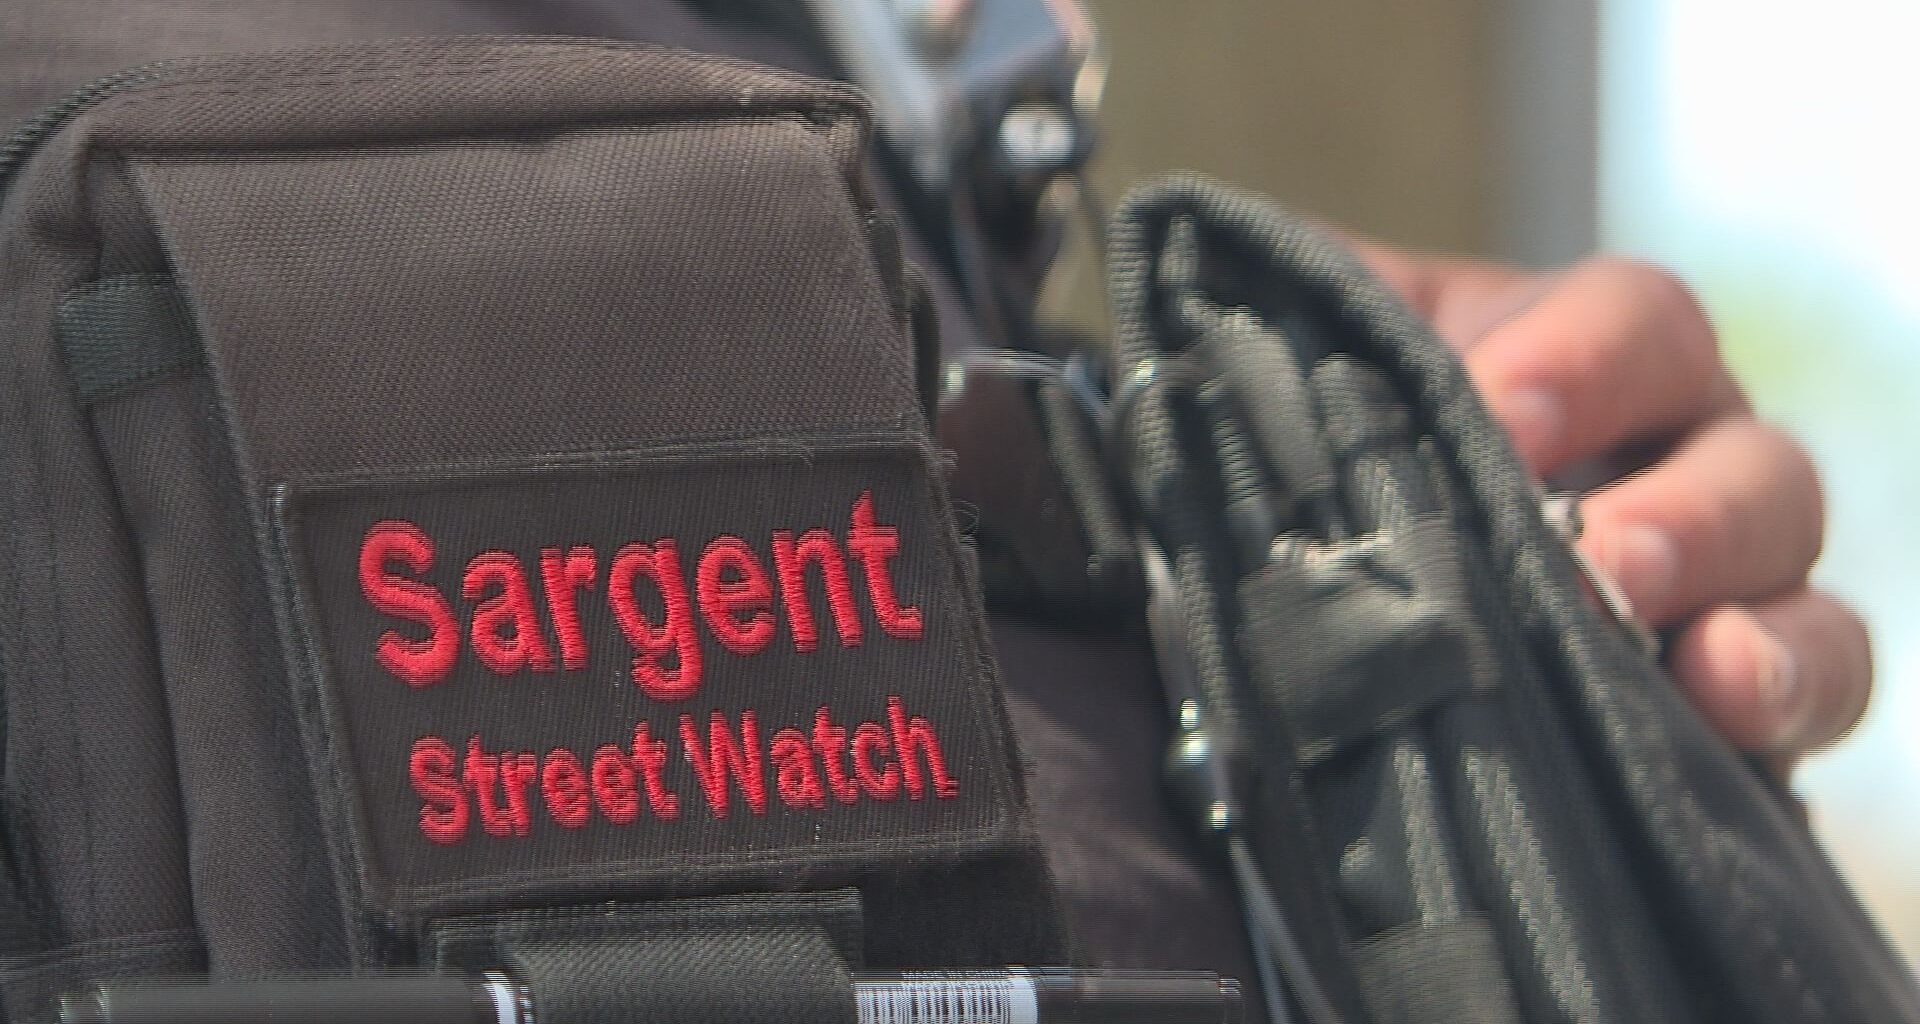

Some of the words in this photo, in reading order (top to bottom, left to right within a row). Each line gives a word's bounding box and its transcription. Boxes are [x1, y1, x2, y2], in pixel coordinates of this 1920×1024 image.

[357, 489, 924, 701] Sargent
[409, 719, 679, 844] Street
[678, 695, 959, 820] Watch
